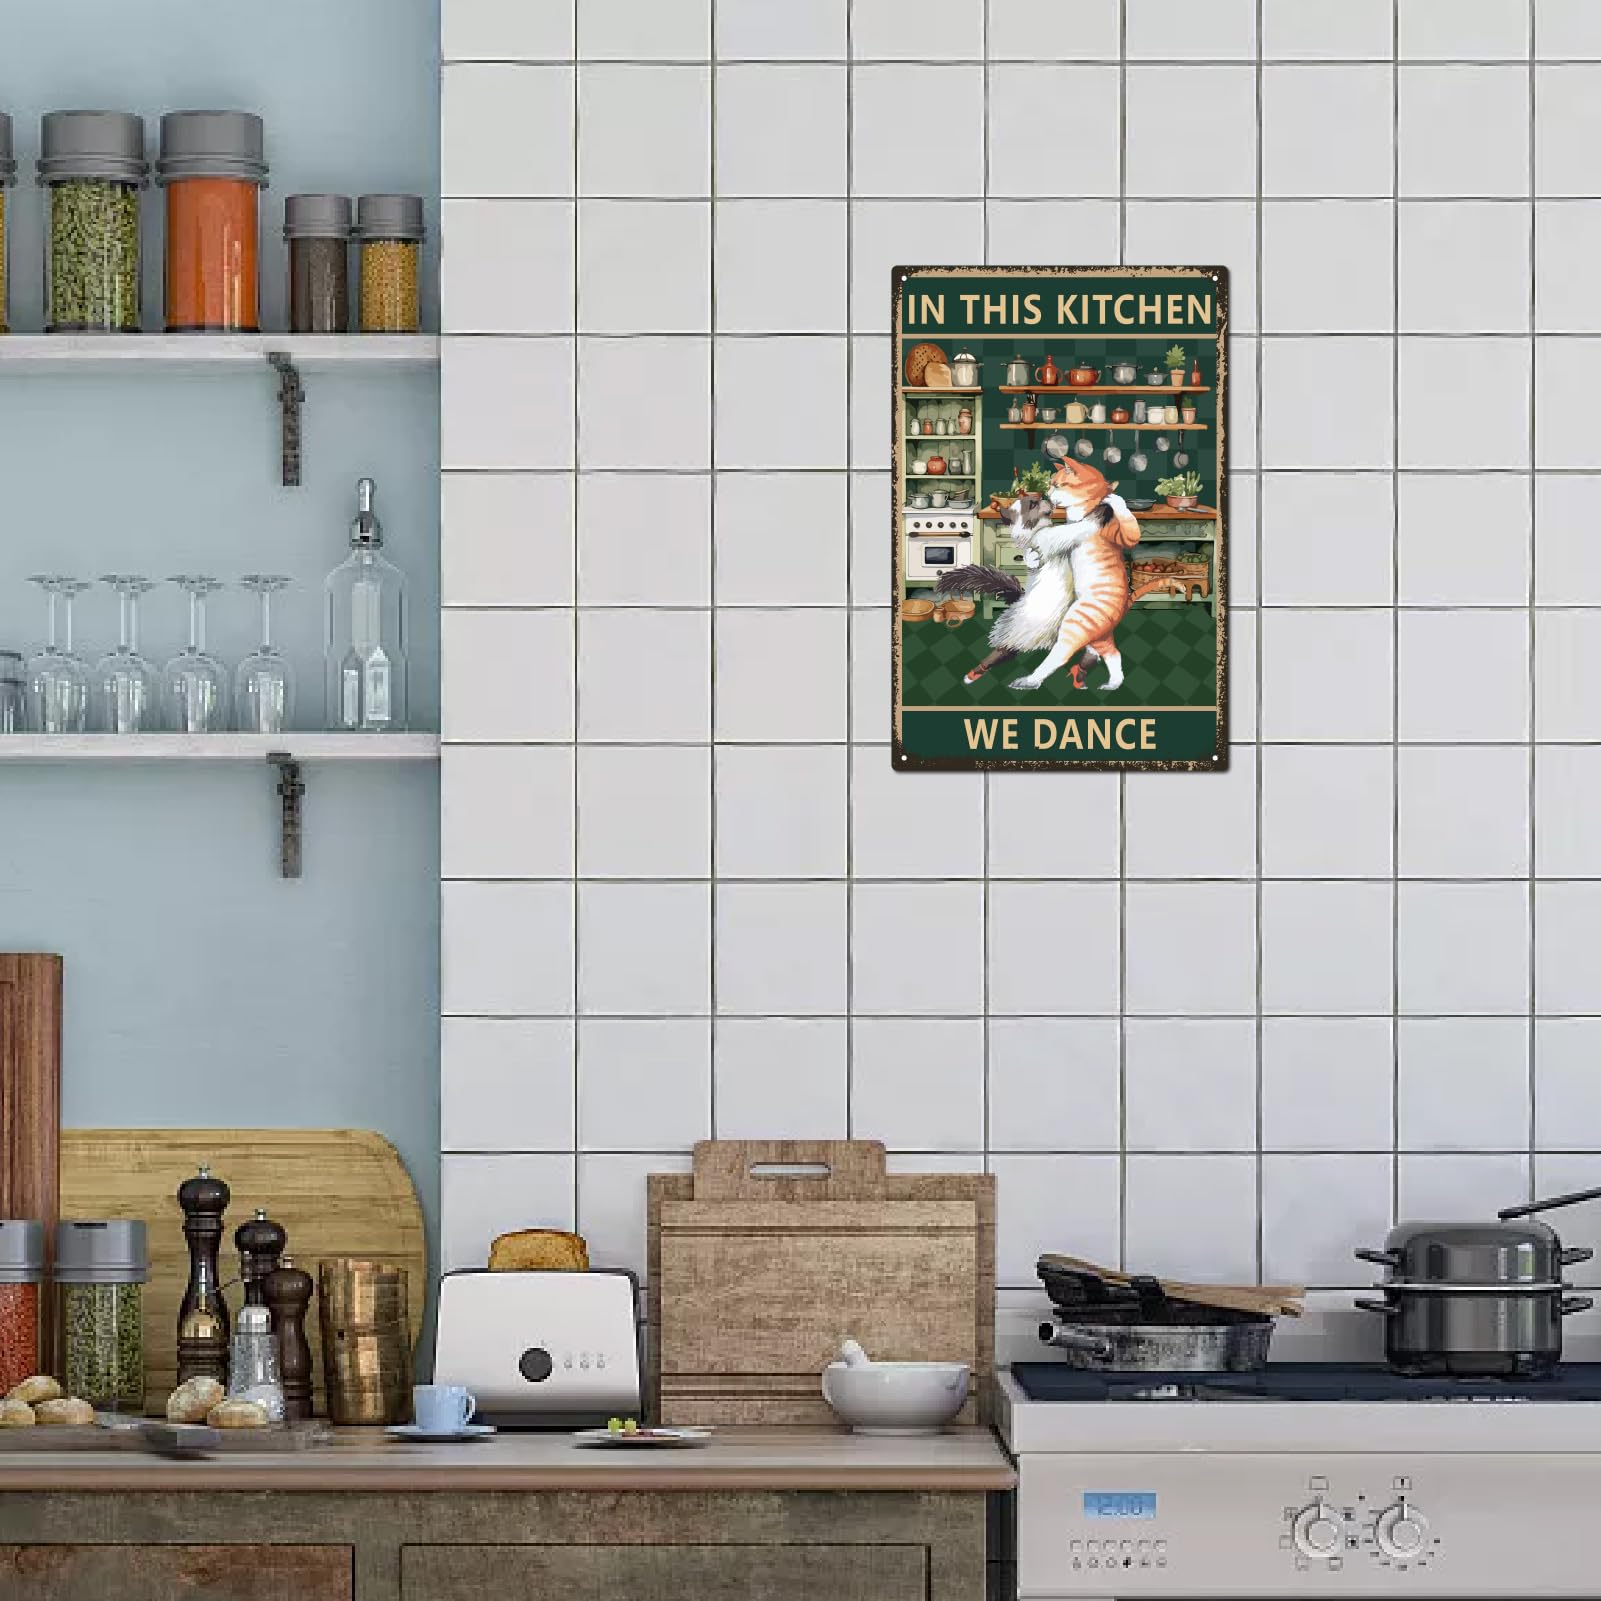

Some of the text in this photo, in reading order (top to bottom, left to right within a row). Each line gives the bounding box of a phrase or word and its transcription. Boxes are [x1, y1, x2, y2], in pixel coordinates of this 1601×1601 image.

[908, 293, 1212, 325] IN THIS KITCHEN
[963, 717, 1157, 751] WE DANCE
